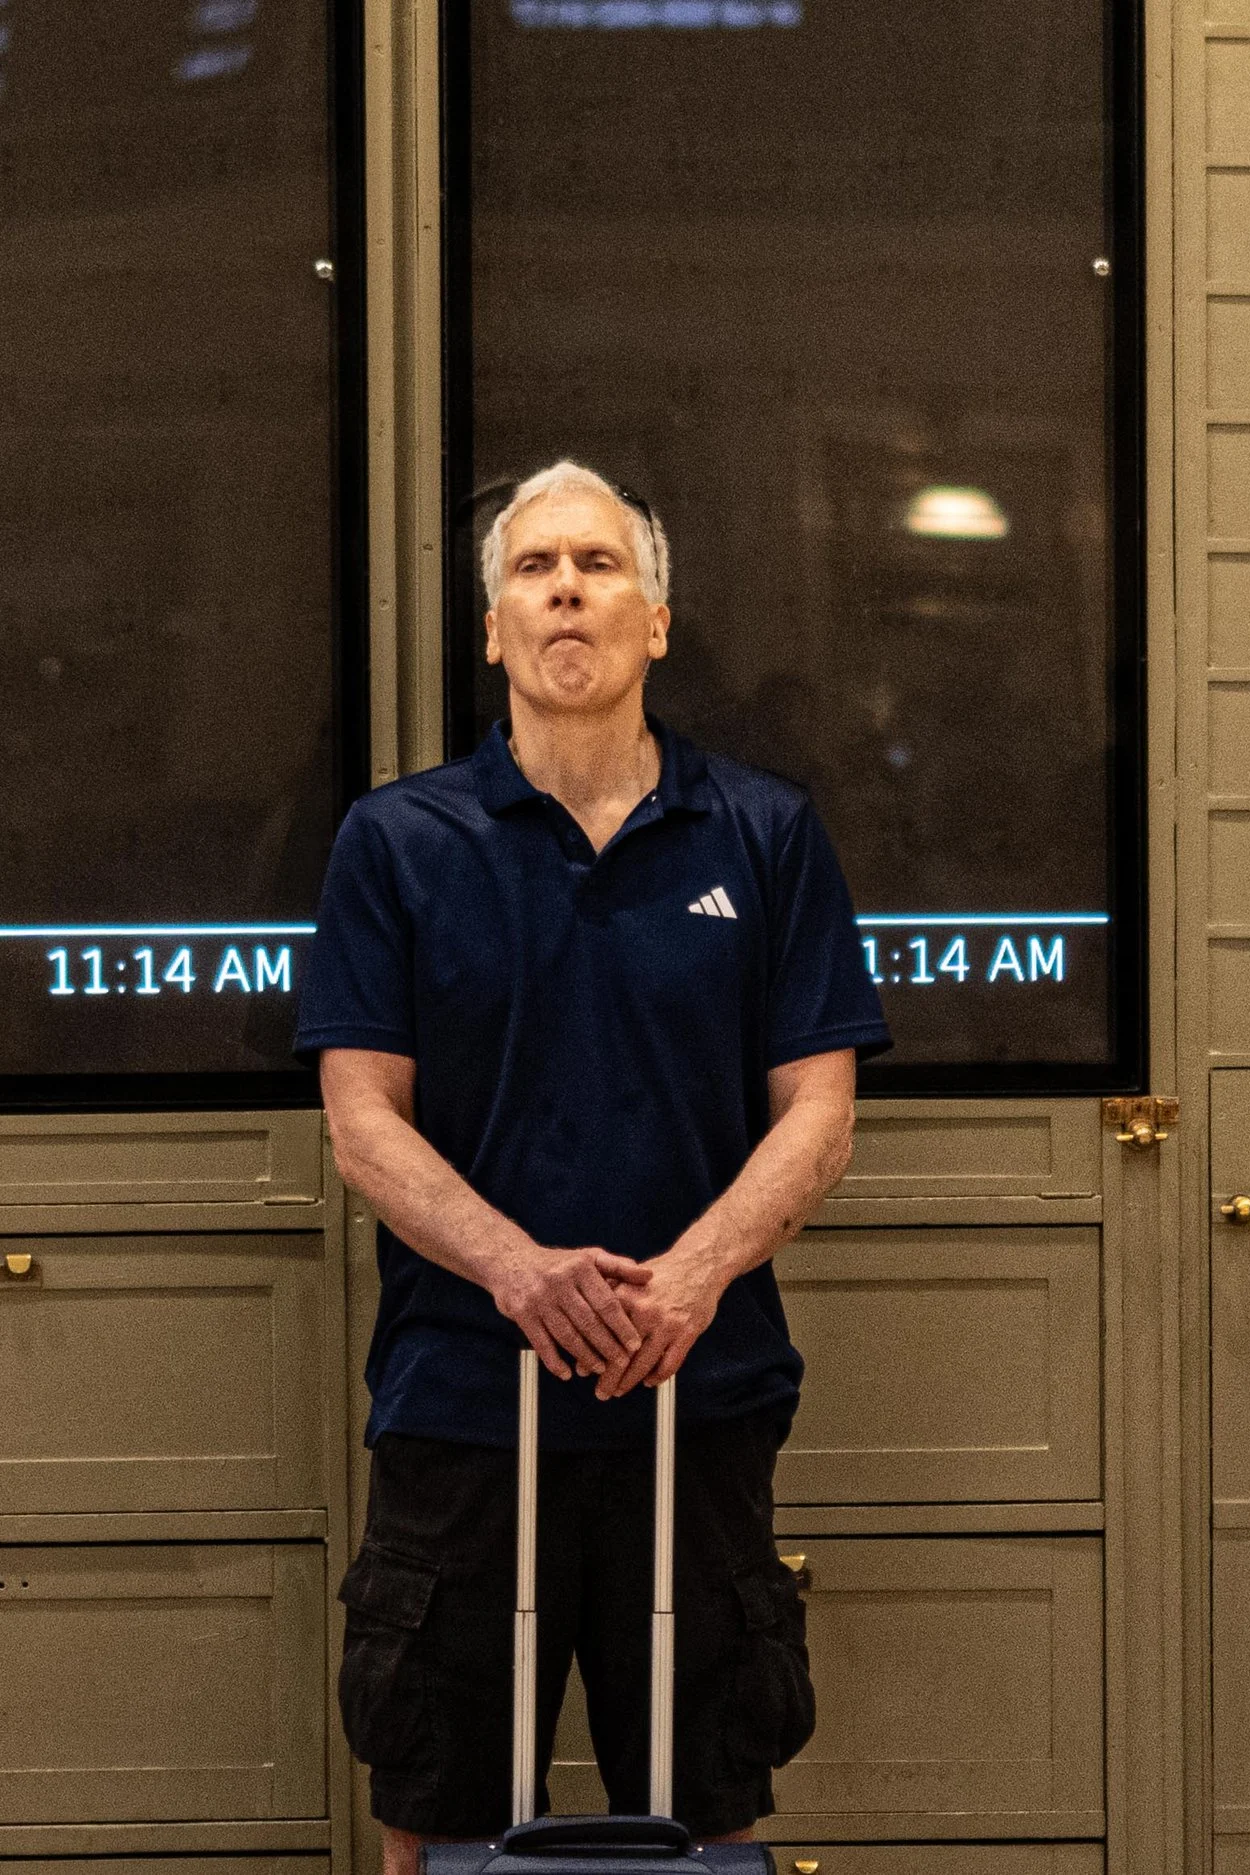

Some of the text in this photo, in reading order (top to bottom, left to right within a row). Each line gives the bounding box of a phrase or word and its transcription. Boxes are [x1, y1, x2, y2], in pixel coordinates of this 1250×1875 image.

[47, 946, 290, 994] 11:14 AM
[862, 936, 1063, 984] 1:14 AM
